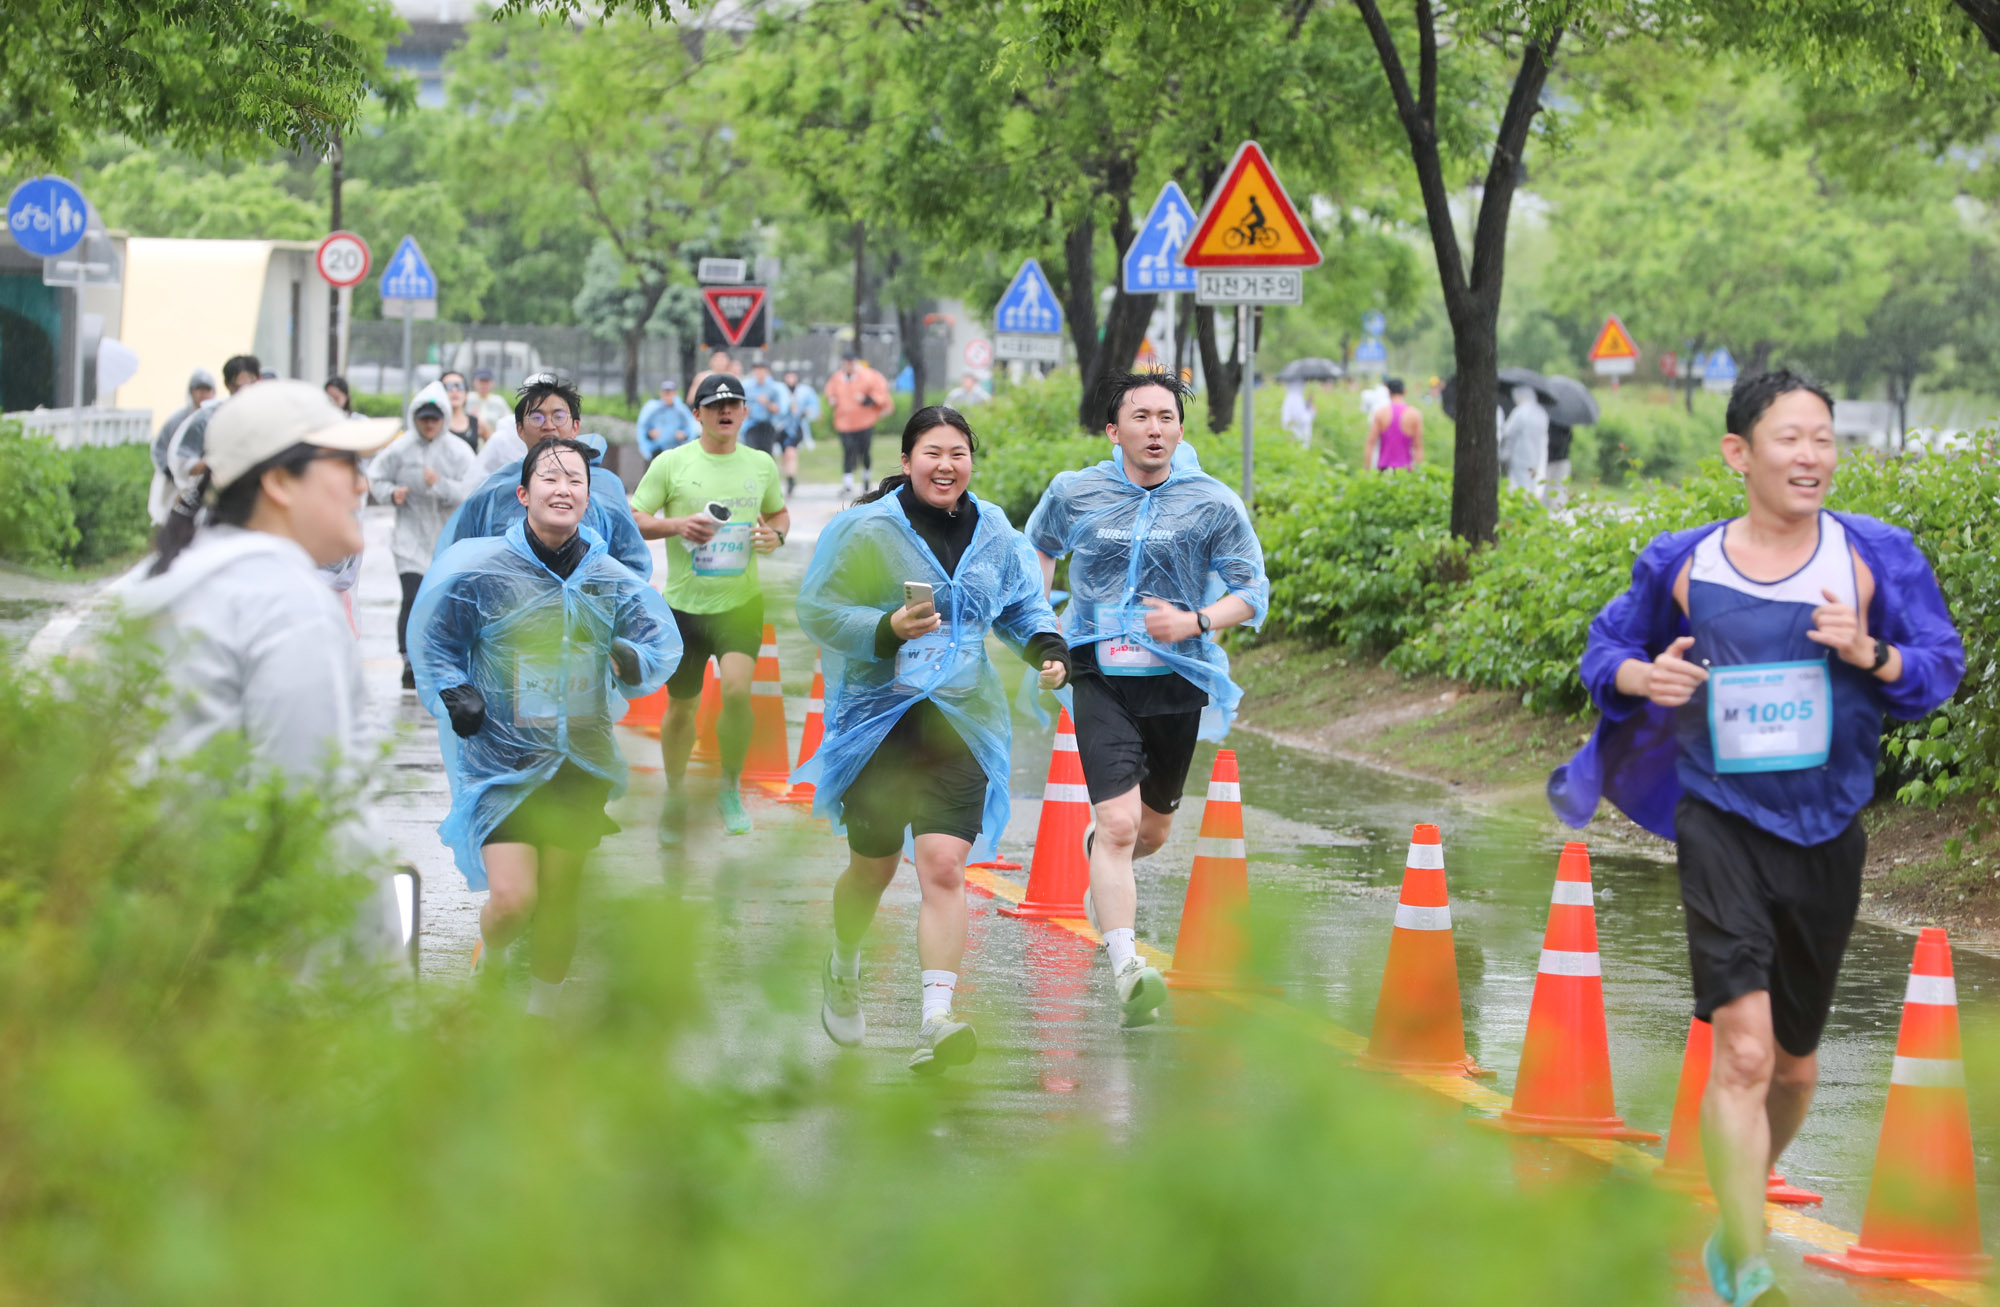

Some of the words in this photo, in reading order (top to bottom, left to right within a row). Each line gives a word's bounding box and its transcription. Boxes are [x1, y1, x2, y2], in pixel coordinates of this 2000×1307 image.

[329, 249, 357, 270] 20
[1204, 276, 1295, 297] 자전거주의
[711, 541, 744, 553] 1794
[1723, 708, 1739, 722] M
[1747, 700, 1813, 723] 1005
